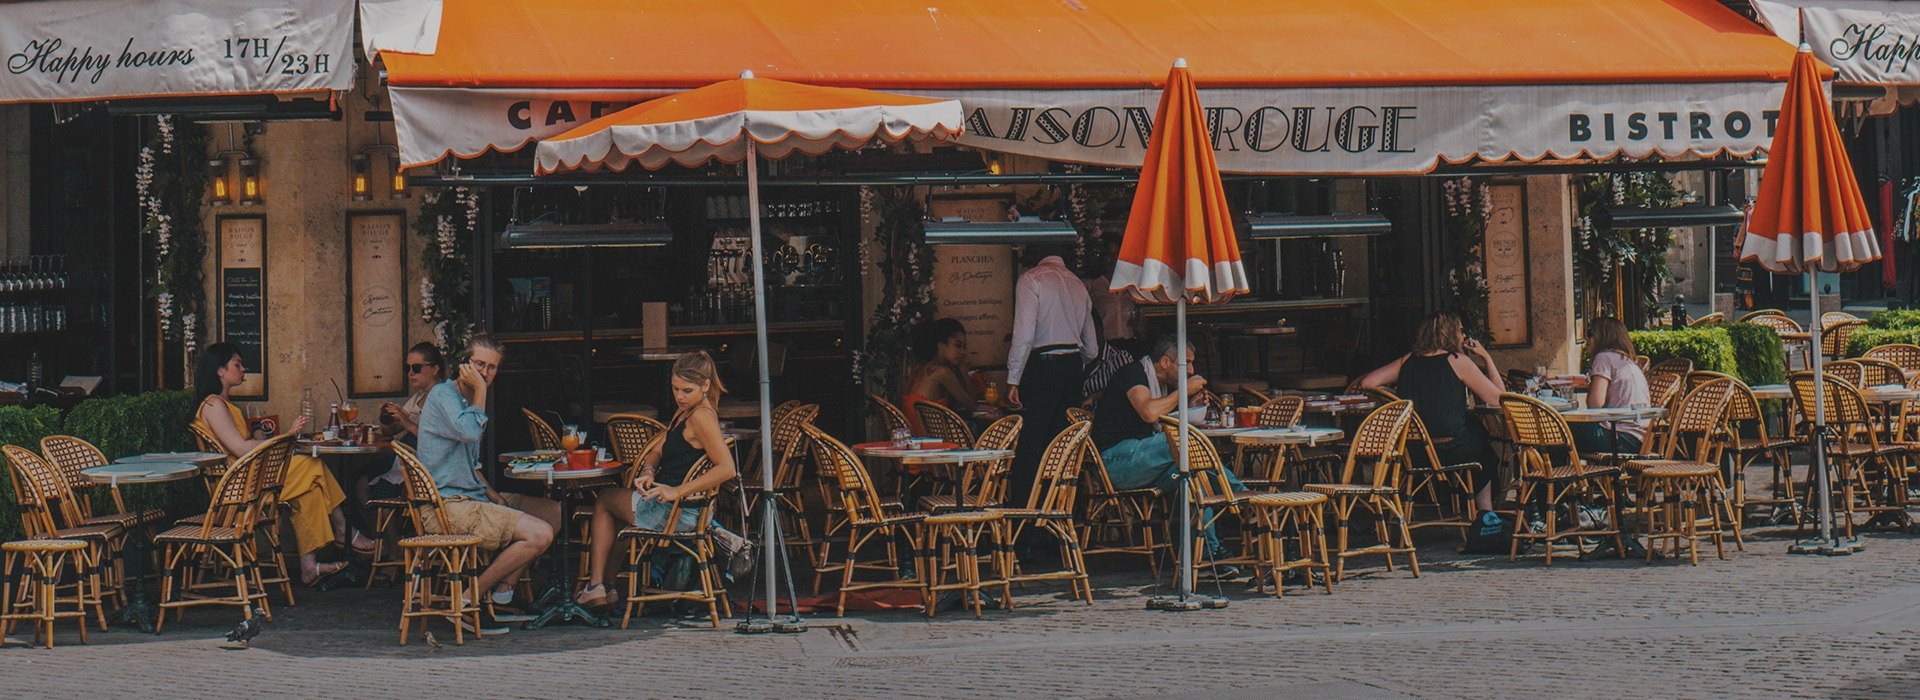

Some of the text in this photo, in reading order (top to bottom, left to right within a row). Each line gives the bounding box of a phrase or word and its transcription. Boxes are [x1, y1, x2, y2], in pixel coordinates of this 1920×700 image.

[7, 37, 196, 84] Happy hours
[1830, 23, 1920, 73] Happ
[507, 100, 638, 130] CAF
[964, 106, 1418, 154] AISON ROUGE
[1569, 110, 1781, 142] BISTROT
[951, 255, 994, 263] PLANCHES
